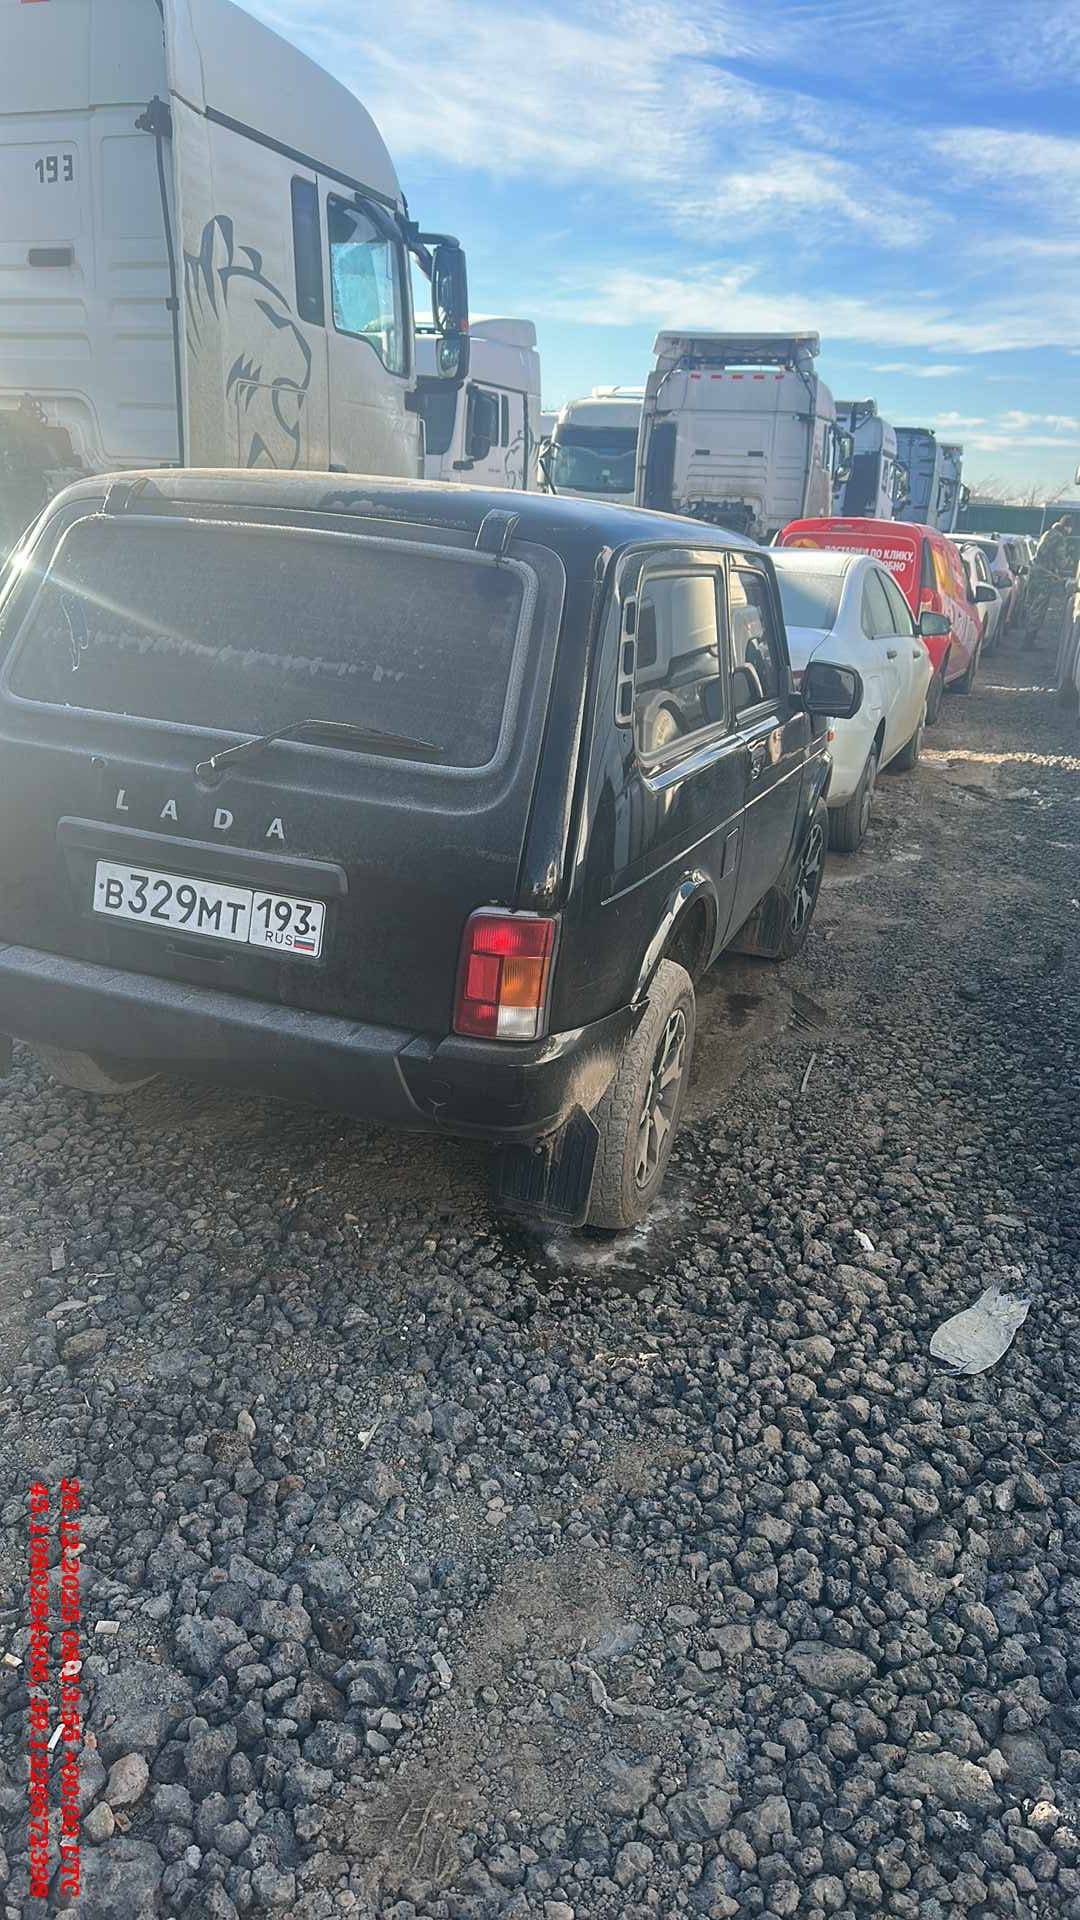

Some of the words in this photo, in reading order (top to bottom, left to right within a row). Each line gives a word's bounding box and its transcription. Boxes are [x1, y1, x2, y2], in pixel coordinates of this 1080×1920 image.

[35, 154, 73, 183] 193
[870, 548, 882, 558] ПО
[883, 549, 914, 564] КЛИКУ,
[115, 789, 285, 840] LADA
[104, 874, 246, 934] В329МТ
[256, 898, 313, 936] 193
[264, 930, 293, 947] RUS
